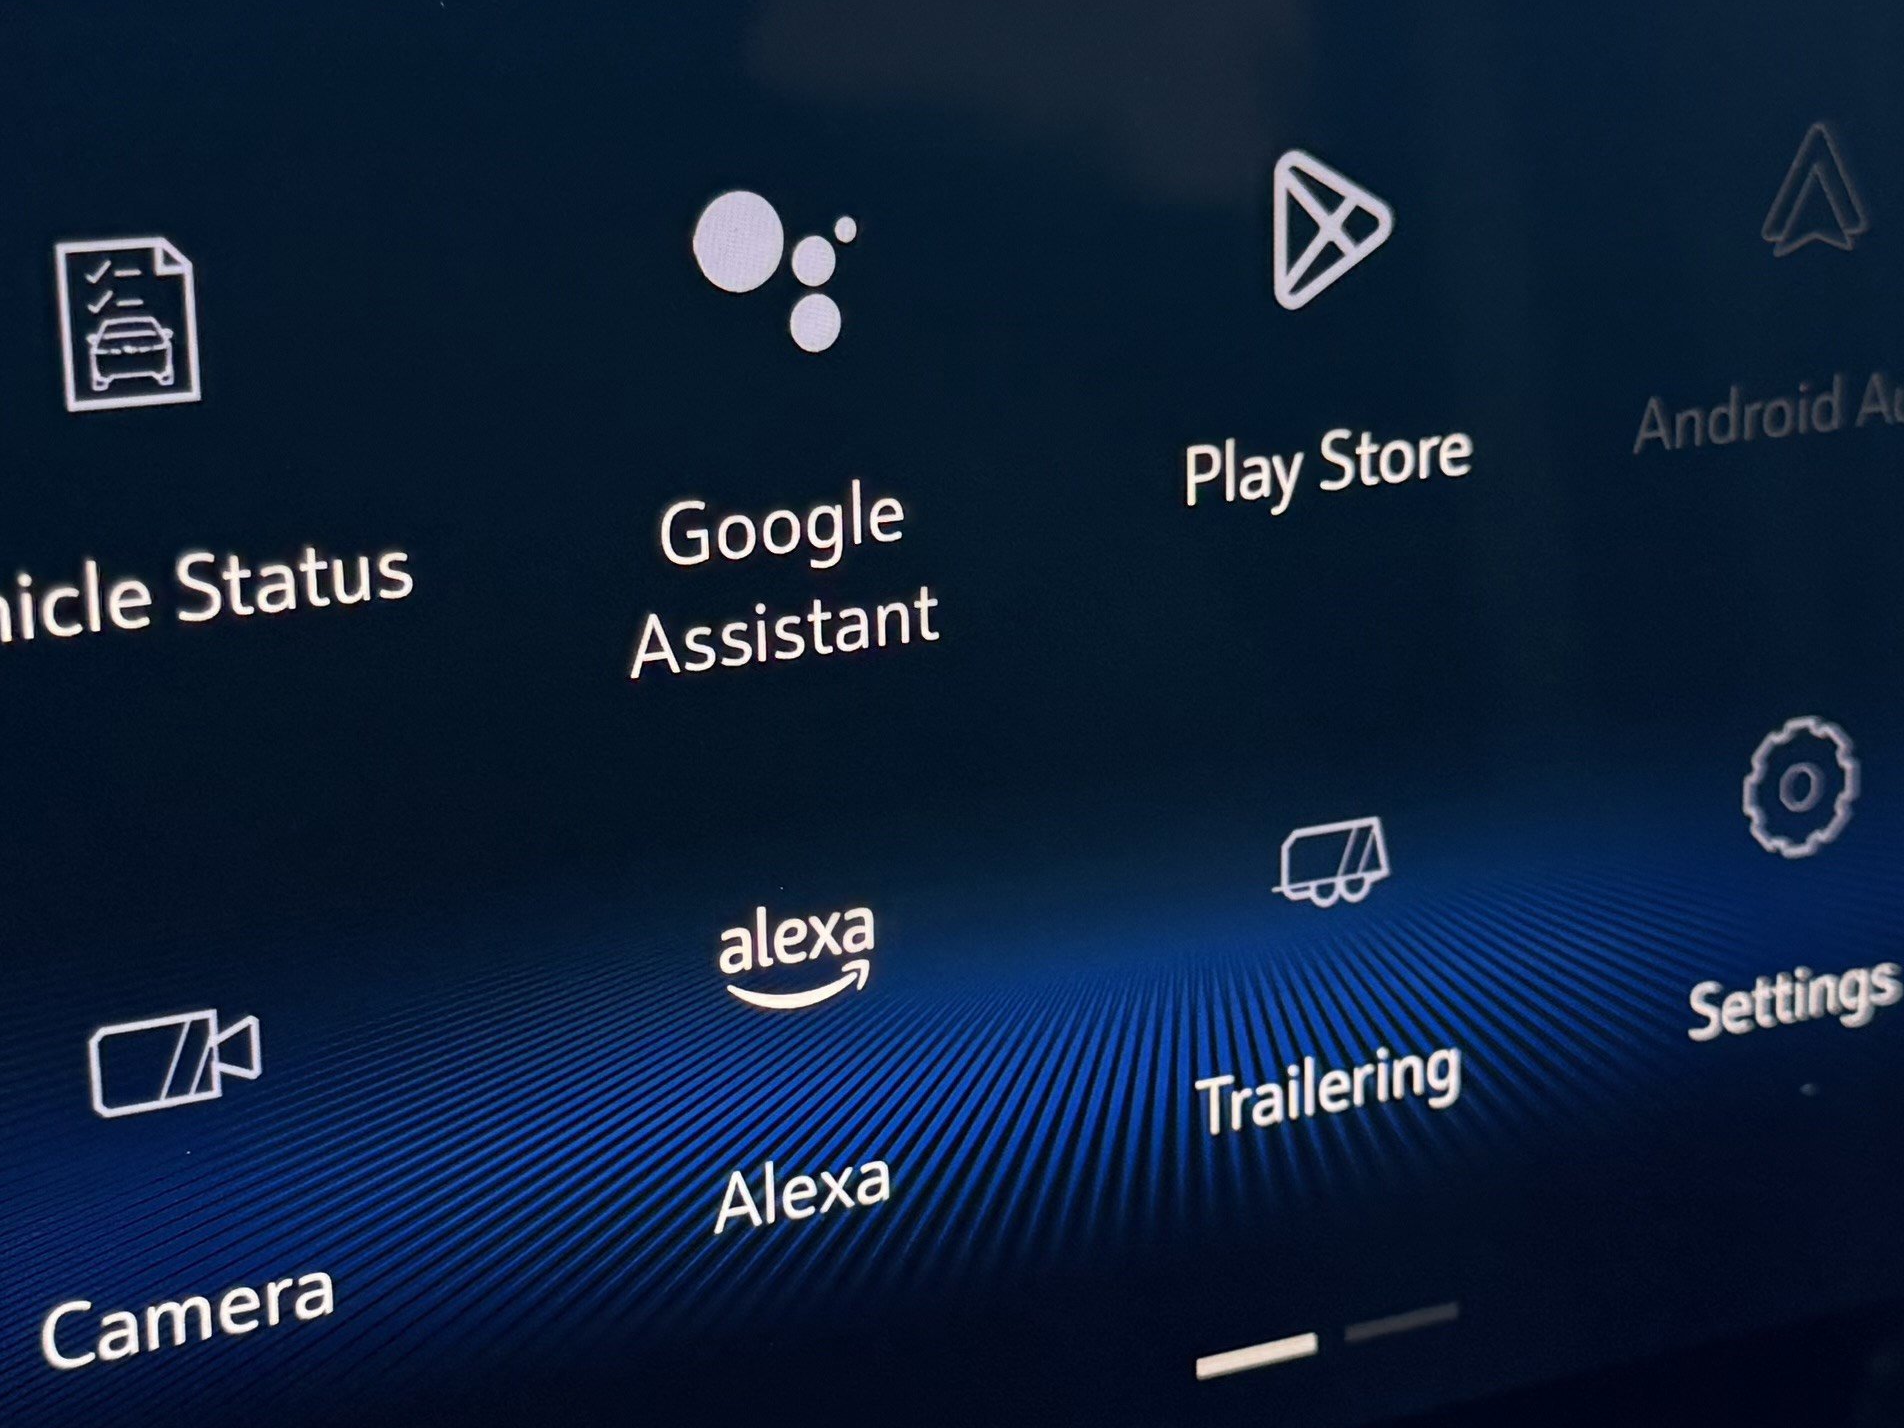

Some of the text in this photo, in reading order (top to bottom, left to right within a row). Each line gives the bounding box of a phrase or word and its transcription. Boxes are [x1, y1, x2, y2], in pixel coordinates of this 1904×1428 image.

[1632, 373, 1842, 454] Android
[1185, 427, 1475, 517] Play Store
[659, 477, 906, 570] Google
[175, 545, 415, 623] Status
[629, 584, 941, 680] Assistant
[717, 904, 876, 976] alexa
[1687, 961, 1904, 1042] Settings
[1193, 1042, 1462, 1136] Trailering
[712, 1156, 892, 1236] Alexa
[40, 1268, 336, 1371] Camera
